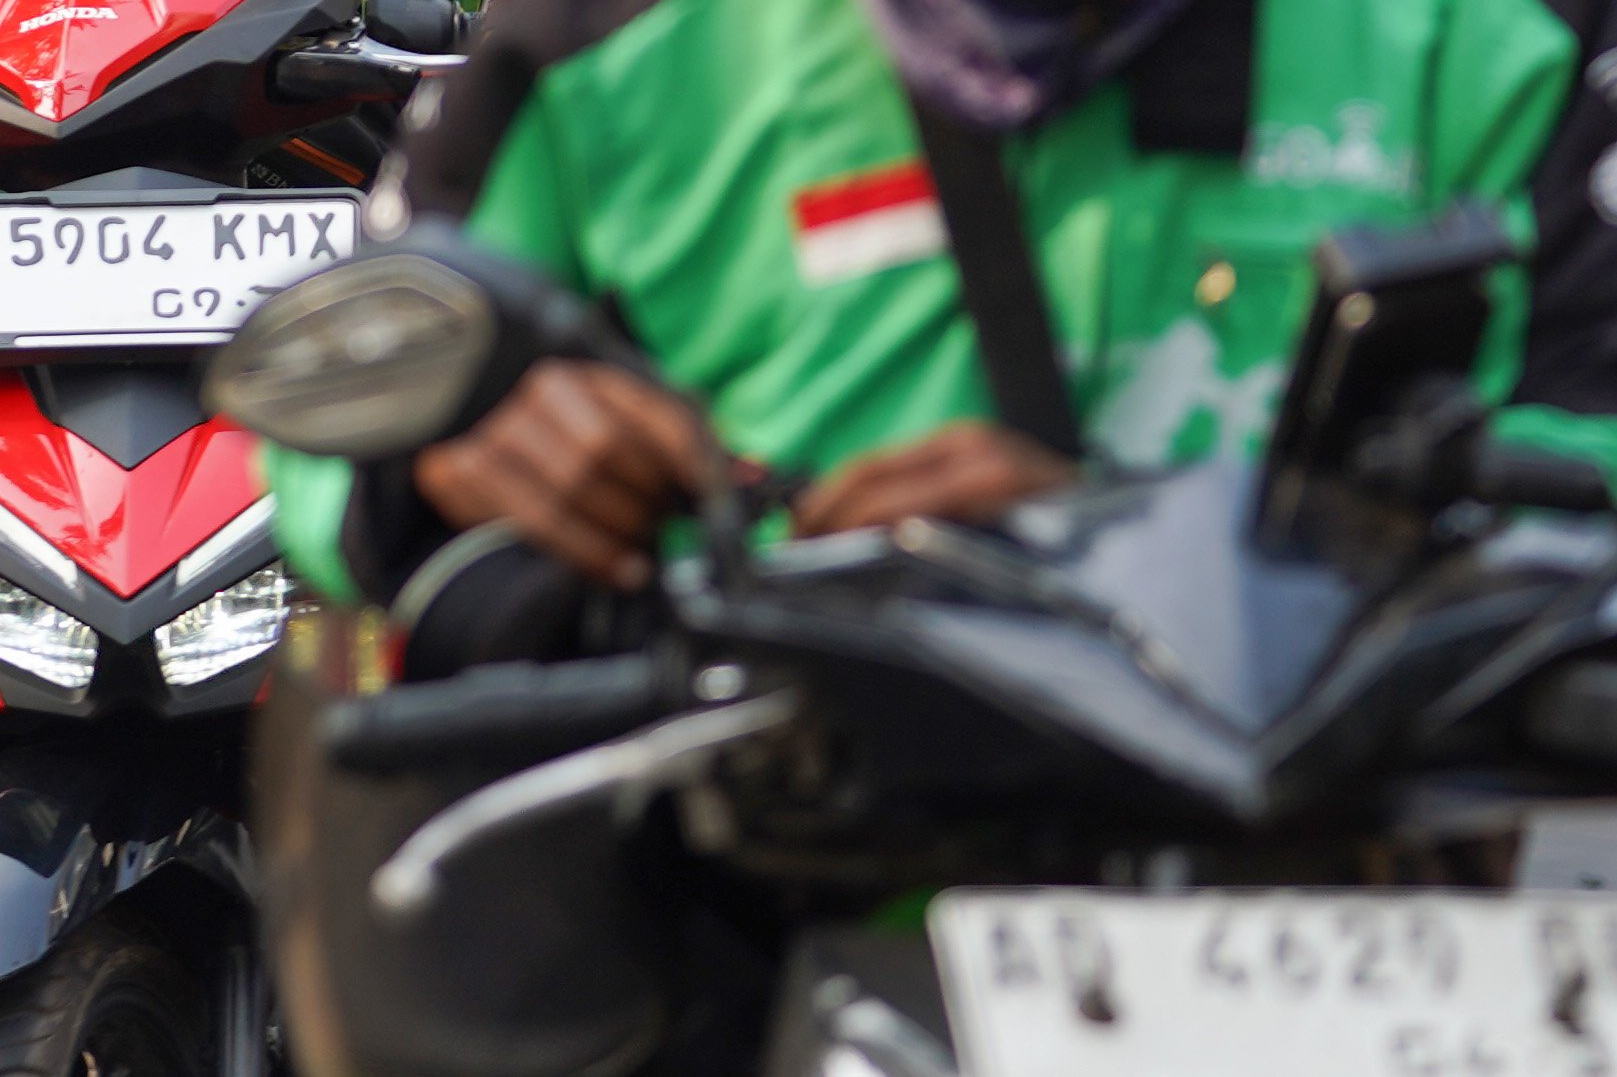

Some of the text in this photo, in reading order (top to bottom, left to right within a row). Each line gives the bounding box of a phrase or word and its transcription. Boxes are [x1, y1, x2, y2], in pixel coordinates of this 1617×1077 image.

[18, 6, 120, 34] HONDA
[9, 215, 176, 268] 5904
[212, 211, 340, 261] KMX
